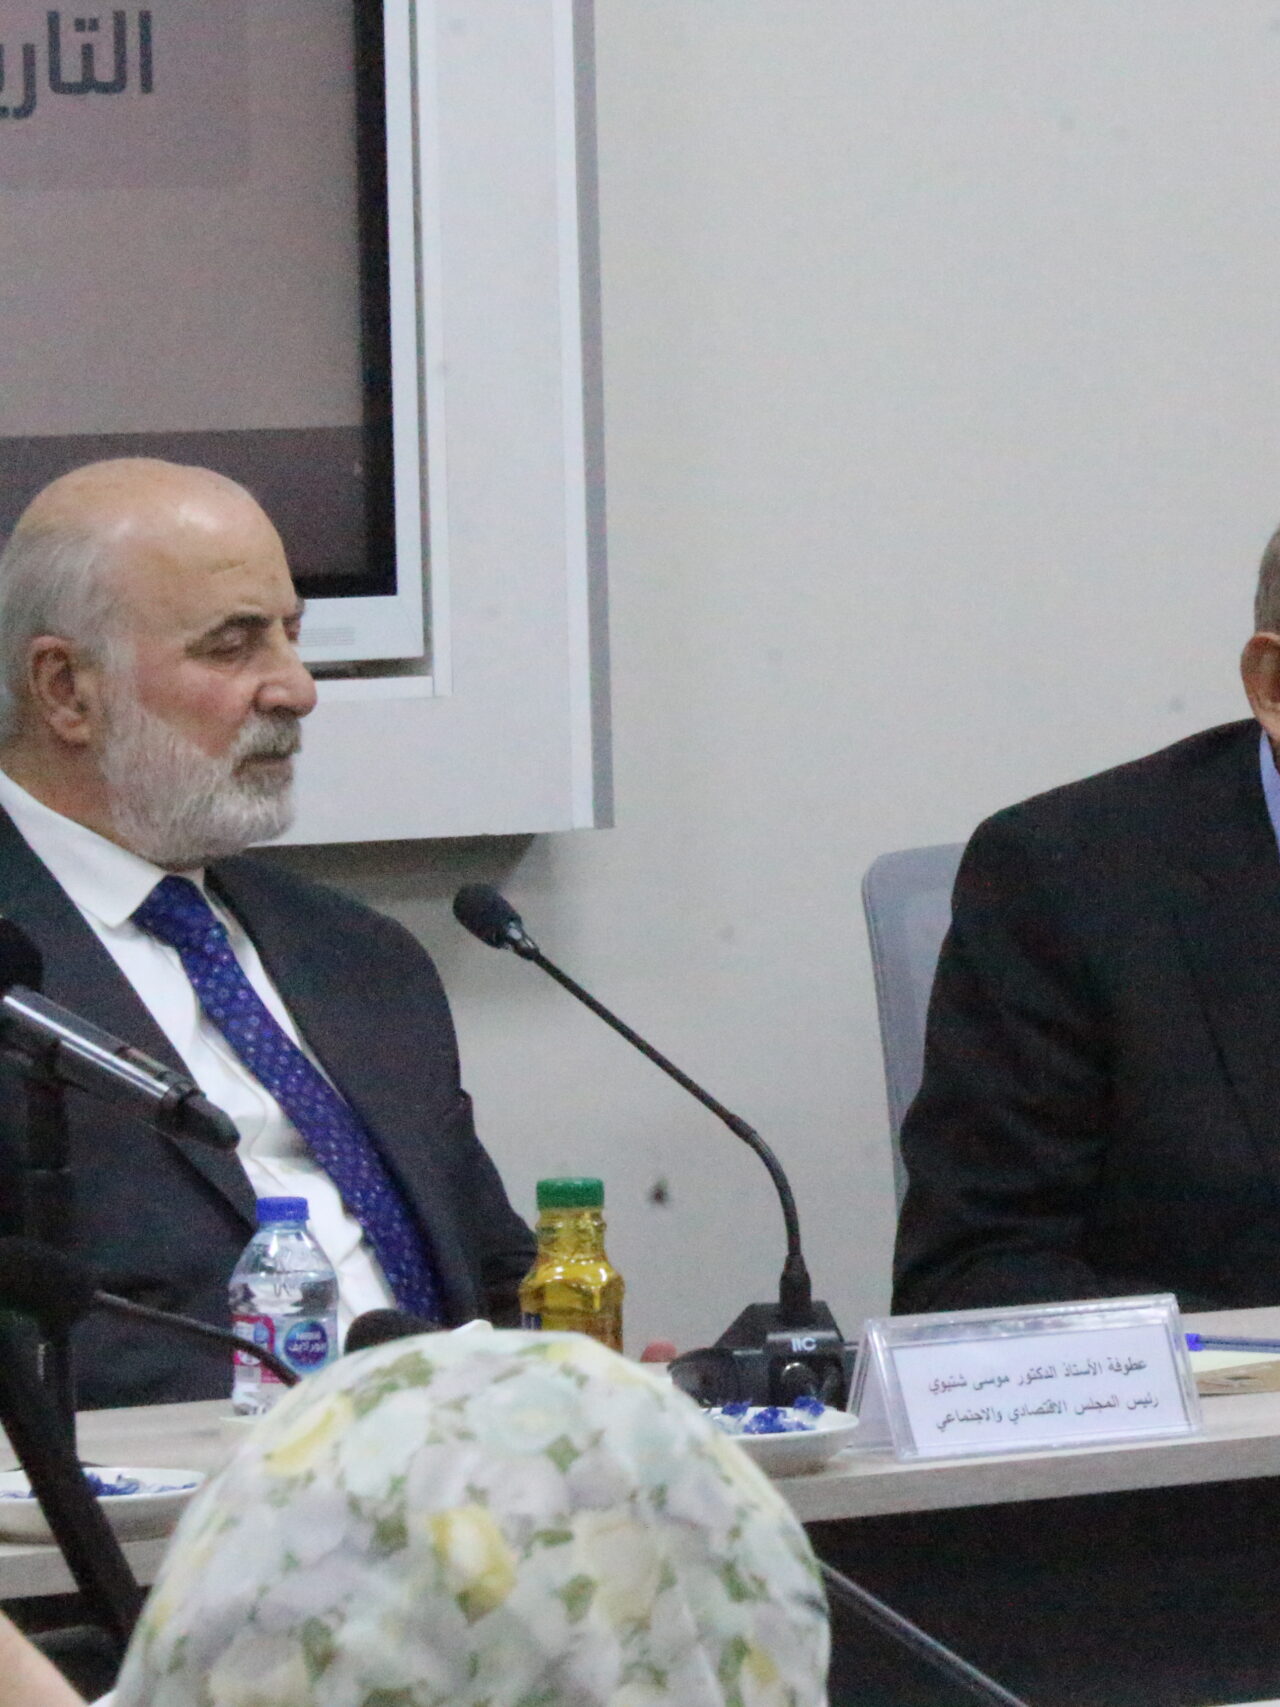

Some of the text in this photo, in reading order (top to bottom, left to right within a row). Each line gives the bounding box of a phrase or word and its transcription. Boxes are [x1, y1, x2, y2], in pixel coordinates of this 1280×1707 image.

[0, 10, 152, 119] التار
[929, 1356, 1147, 1395] عطوفة الأستاذ الدكتور موسى شتيوي
[936, 1392, 1159, 1433] رئيس المجلس الاقتصادي والاجتماعي
